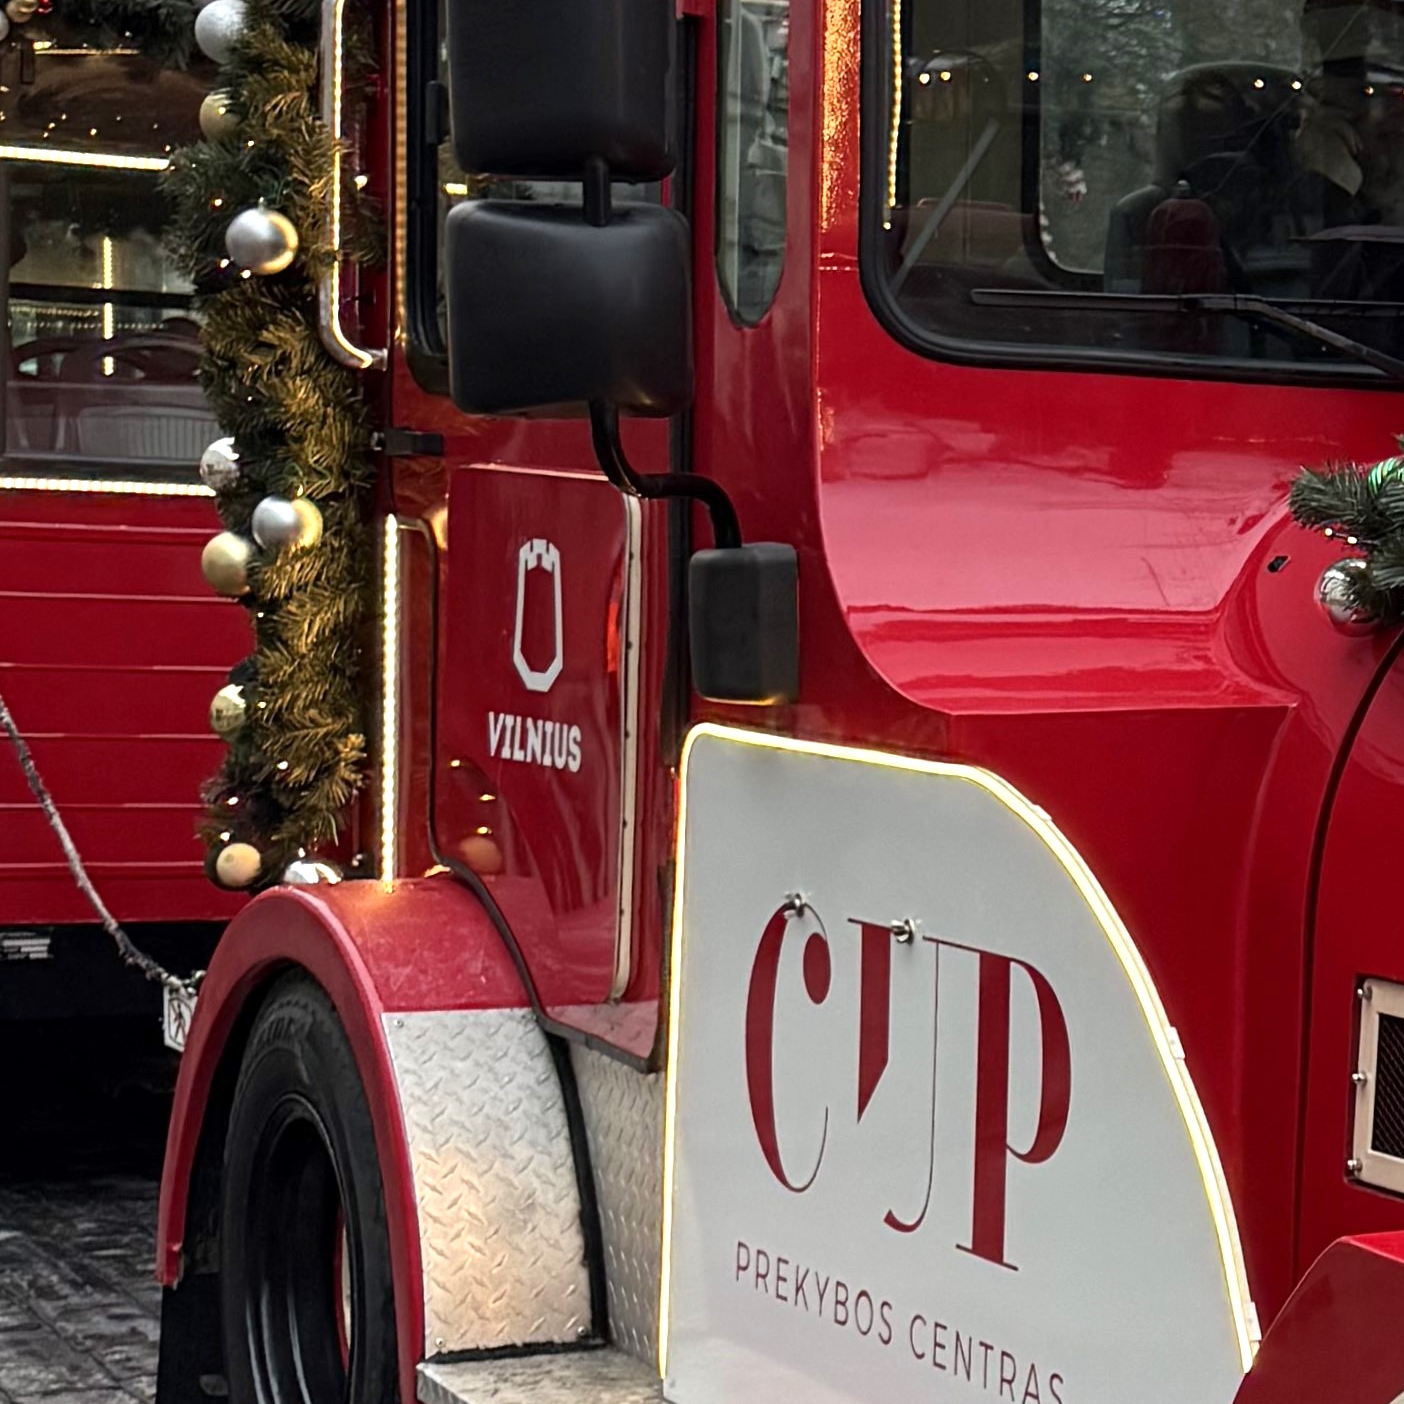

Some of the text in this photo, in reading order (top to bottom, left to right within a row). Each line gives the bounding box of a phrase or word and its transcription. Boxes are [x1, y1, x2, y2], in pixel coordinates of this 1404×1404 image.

[488, 711, 582, 773] VILNIUS
[745, 900, 1072, 1271] CUP
[736, 1241, 893, 1345] PREKYBOS
